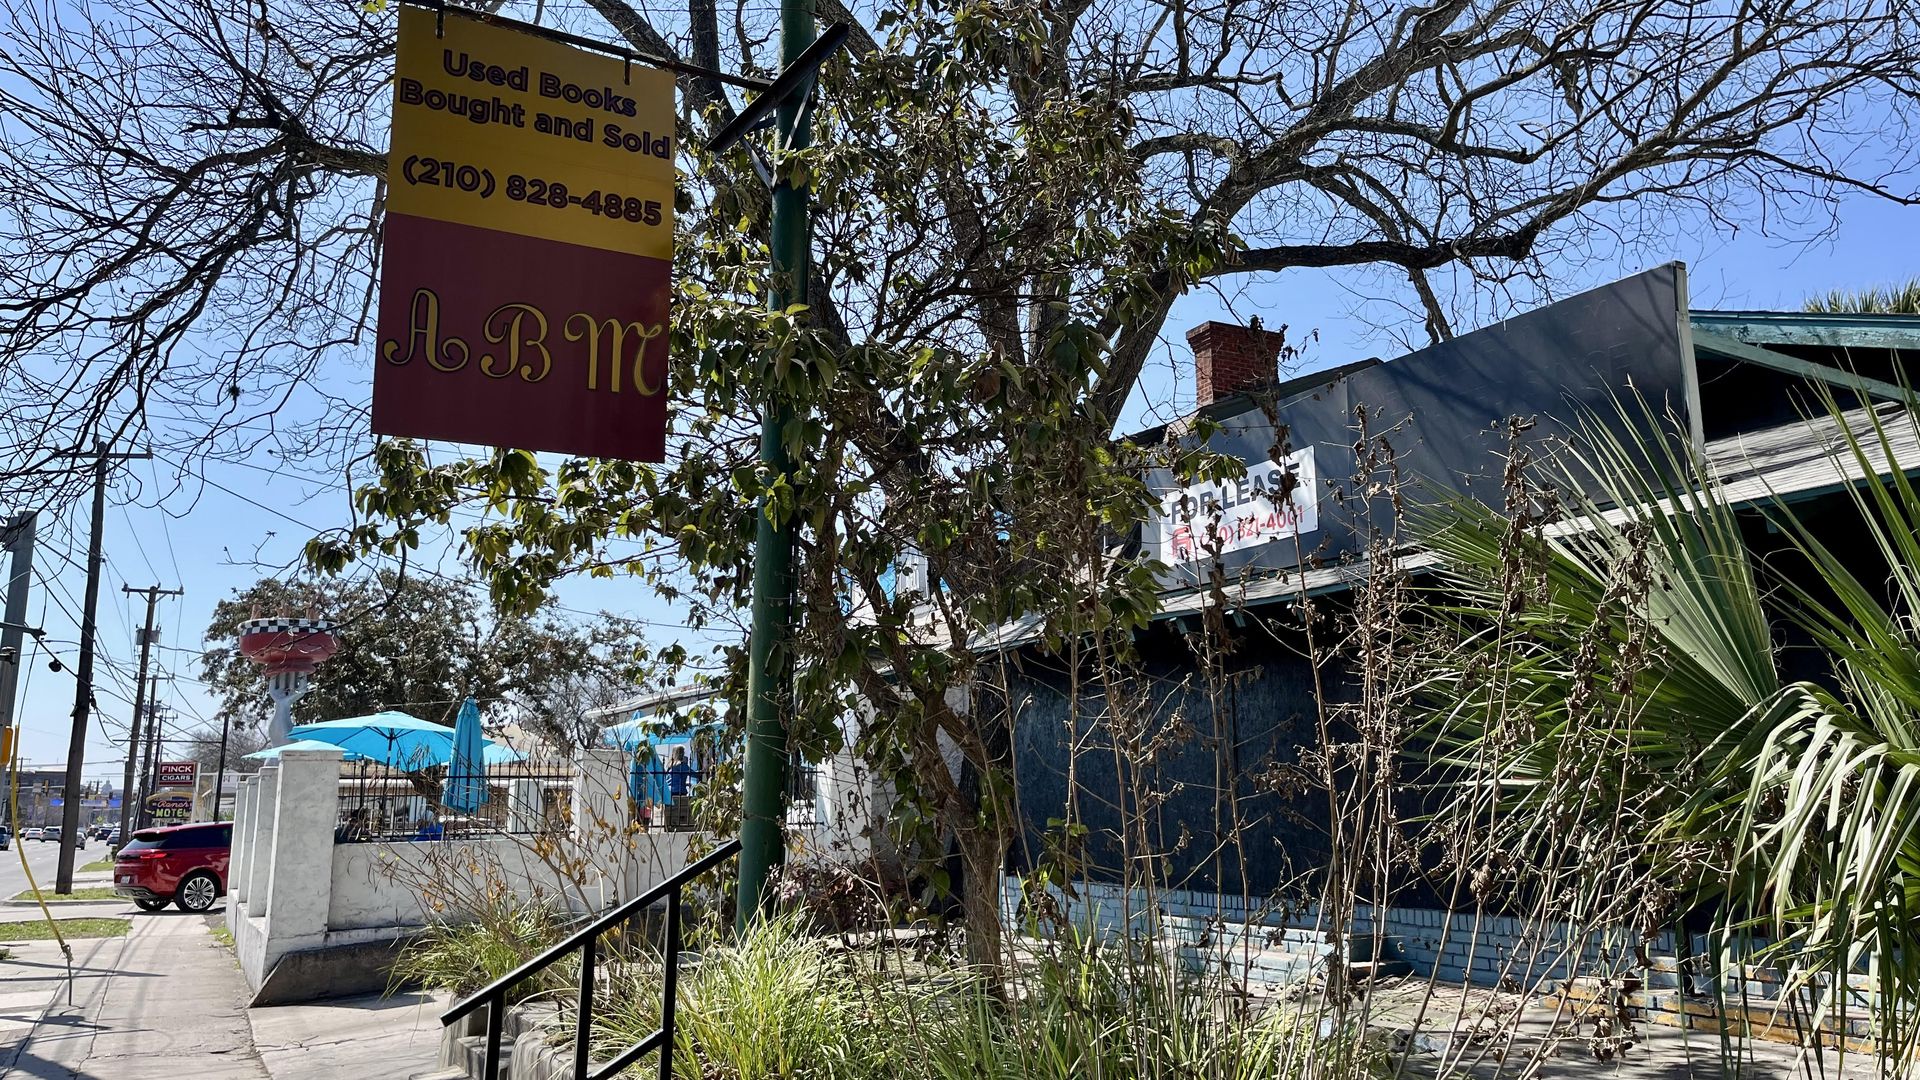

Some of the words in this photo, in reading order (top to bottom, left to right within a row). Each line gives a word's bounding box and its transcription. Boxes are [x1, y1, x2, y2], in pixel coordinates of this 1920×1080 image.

[443, 48, 528, 92] Used
[539, 71, 637, 117] Books
[400, 78, 525, 128] Bought
[534, 111, 594, 142] and
[603, 122, 671, 160] Sold
[402, 154, 496, 198] (210)
[507, 174, 662, 227] 828-4885
[1171, 491, 1215, 525] FOR
[1221, 462, 1301, 510] LEASE
[161, 765, 192, 773] FINCK
[155, 808, 191, 818] MOTEL
